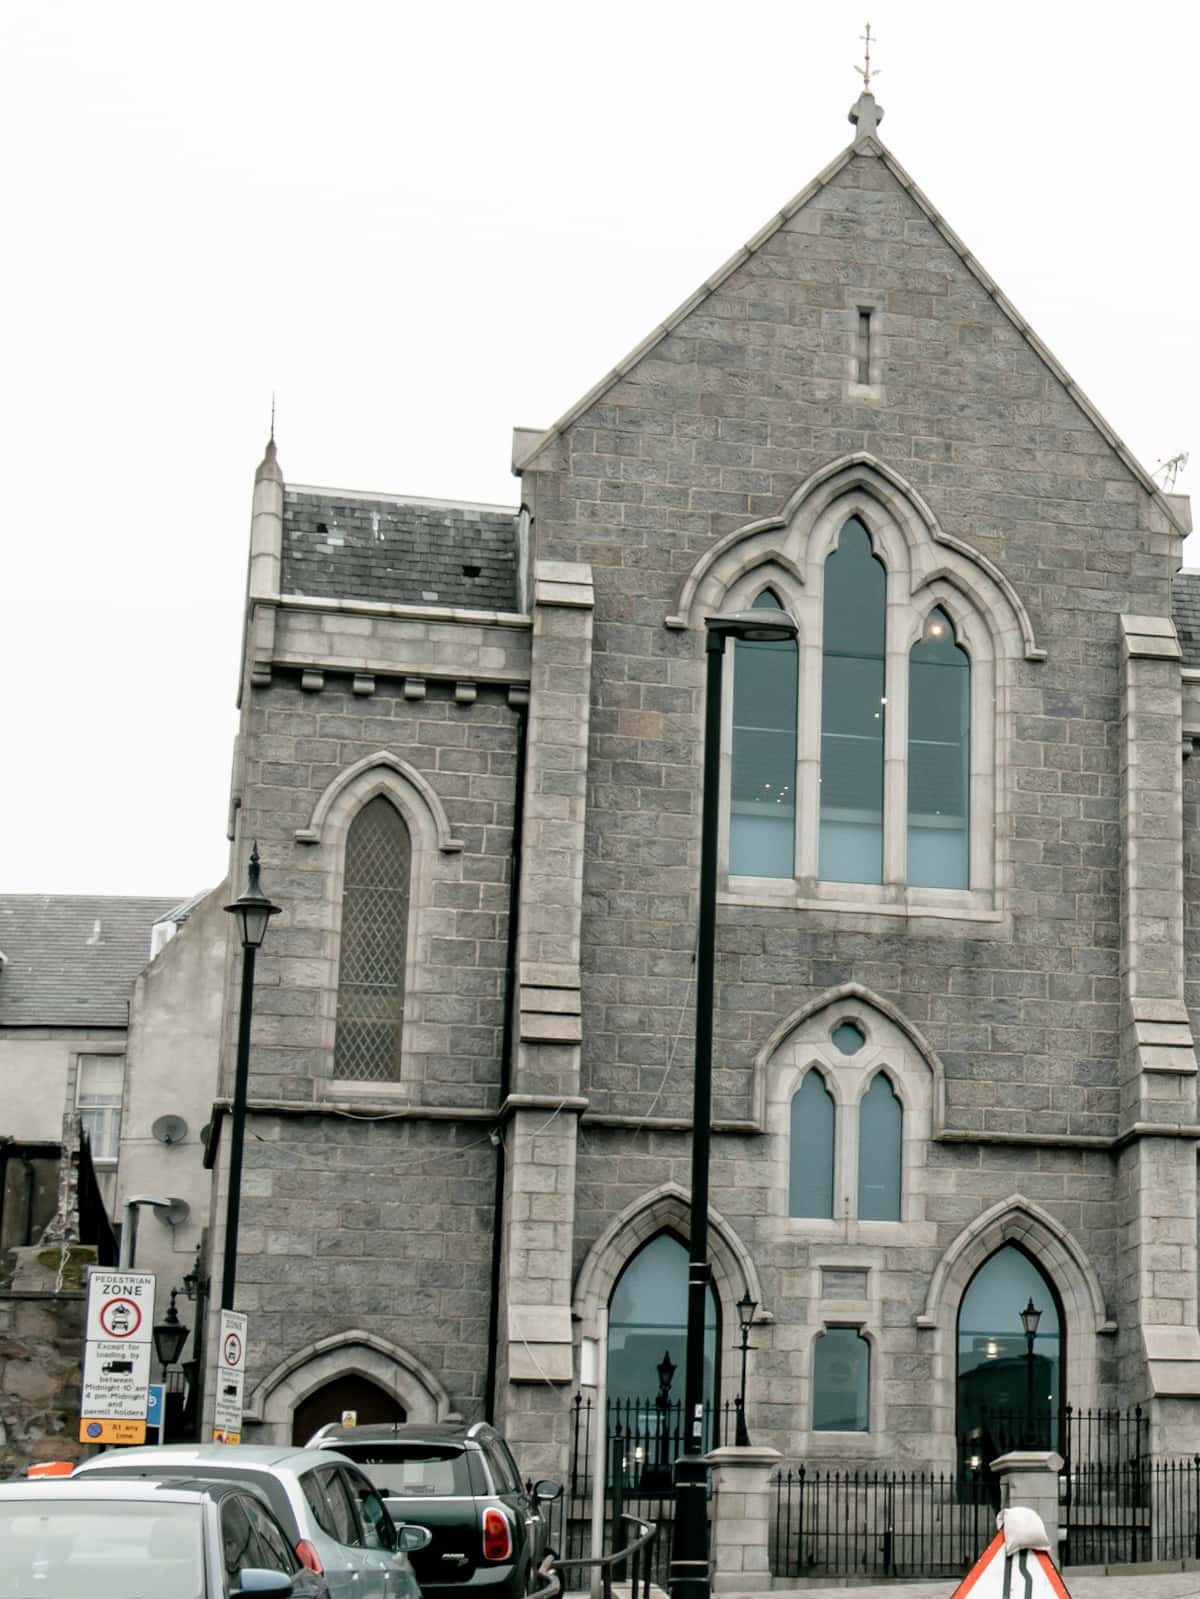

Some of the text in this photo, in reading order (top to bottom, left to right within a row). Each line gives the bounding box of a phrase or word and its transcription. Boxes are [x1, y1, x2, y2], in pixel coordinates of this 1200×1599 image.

[96, 1275, 151, 1284] PEDESTRIAN
[102, 1284, 142, 1296] ZONE
[96, 1352, 126, 1360] loading
